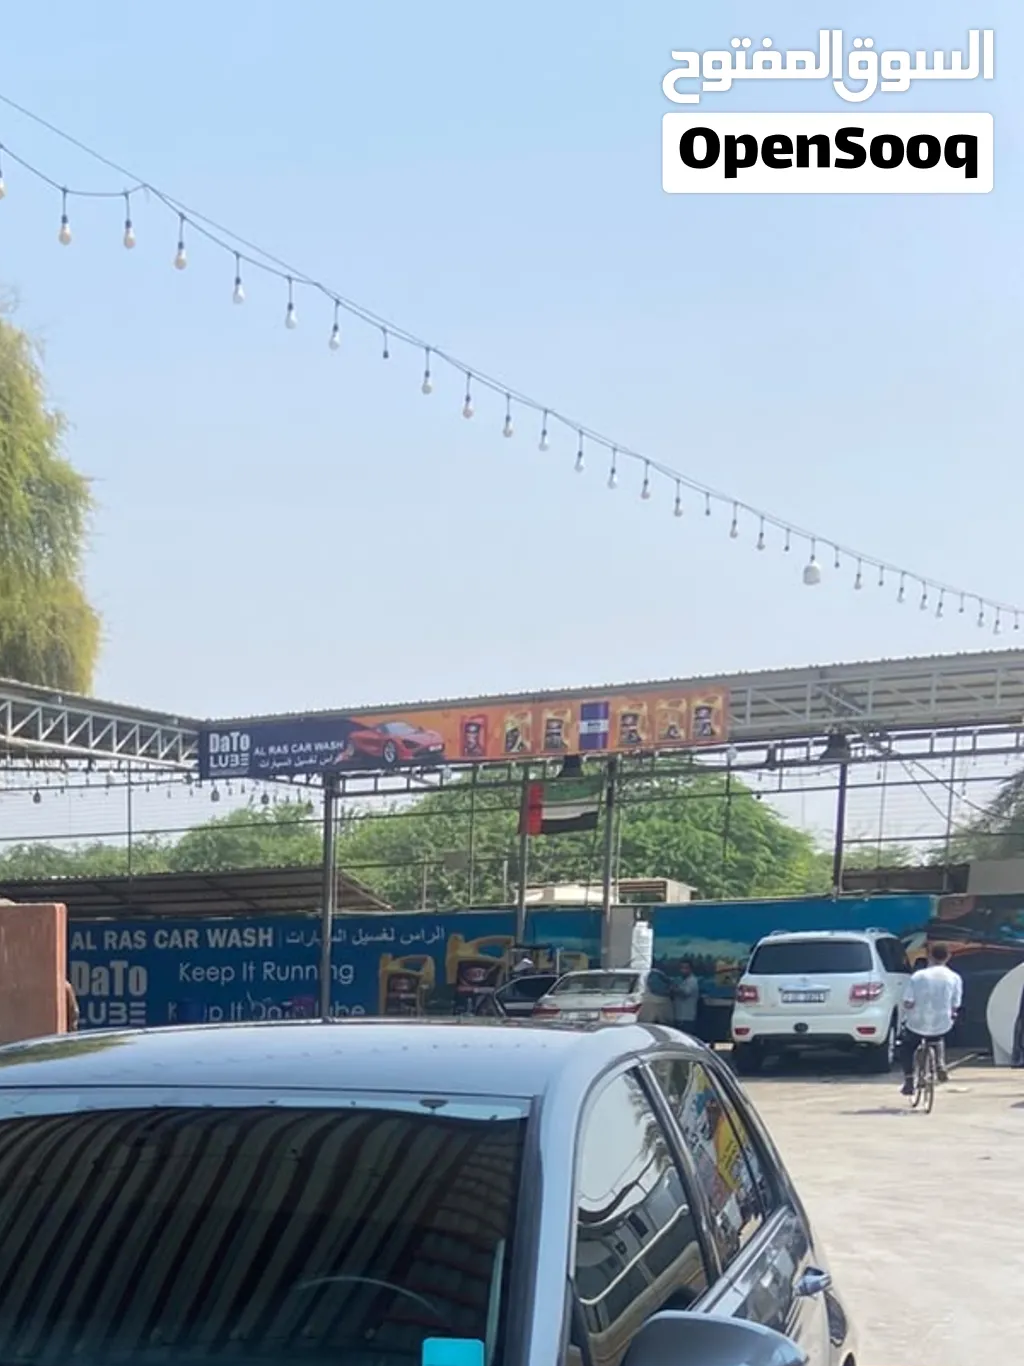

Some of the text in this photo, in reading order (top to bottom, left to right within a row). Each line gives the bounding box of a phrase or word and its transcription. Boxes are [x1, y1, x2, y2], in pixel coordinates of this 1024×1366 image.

[209, 732, 251, 753] DaTo
[253, 740, 345, 756] AL RAS CAR WASH
[71, 927, 273, 950] AL RAS CAR WASH
[351, 927, 396, 946] لغسيل
[70, 960, 148, 997] DaTo
[179, 962, 235, 987] Keep
[242, 961, 256, 982] It
